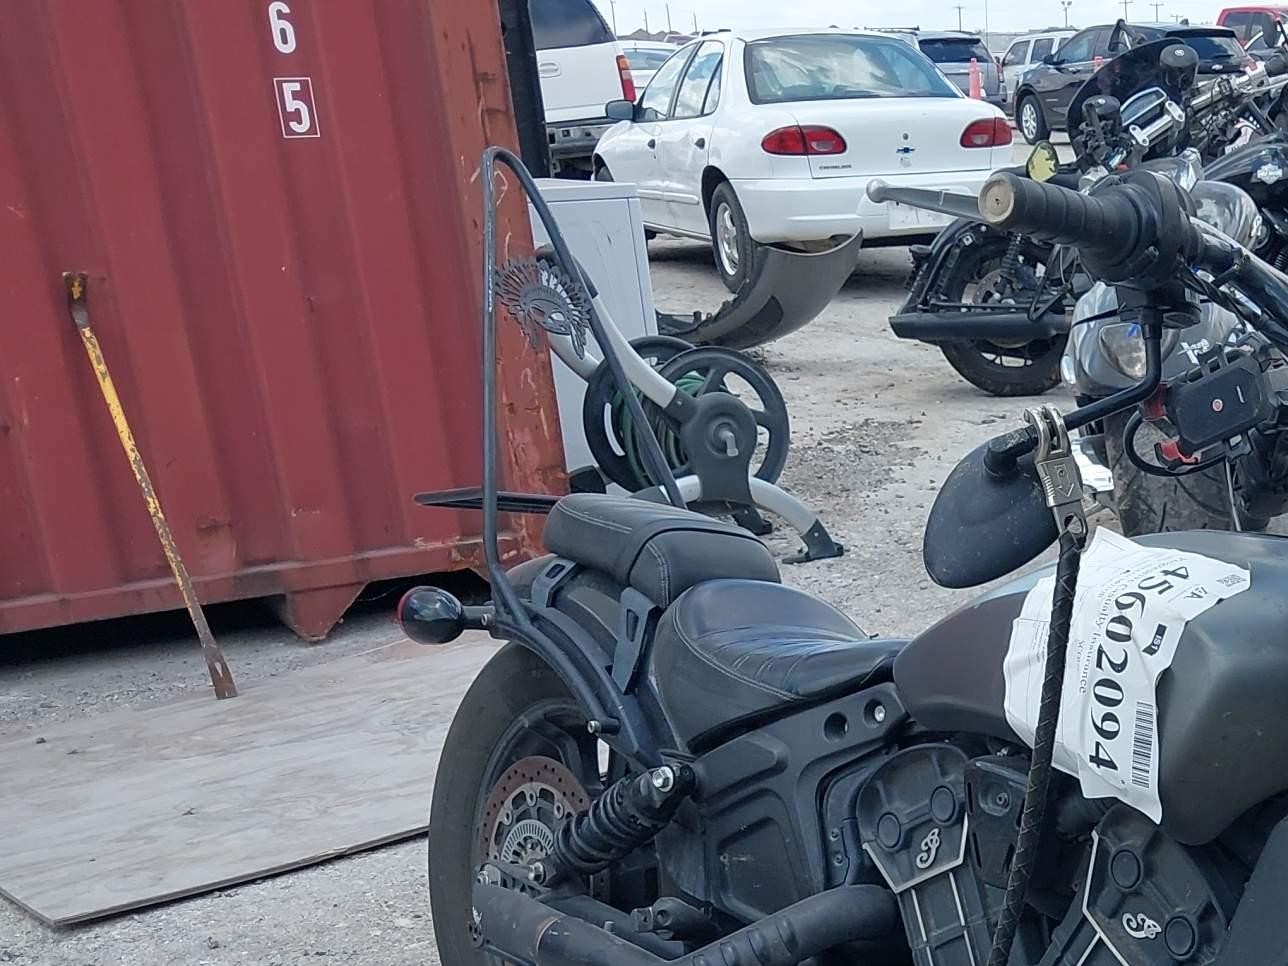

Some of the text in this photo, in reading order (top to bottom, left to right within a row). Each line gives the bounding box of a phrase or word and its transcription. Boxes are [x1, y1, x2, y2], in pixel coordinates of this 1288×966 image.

[268, 1, 311, 133] 6 5
[1088, 565, 1190, 773] 45602094
